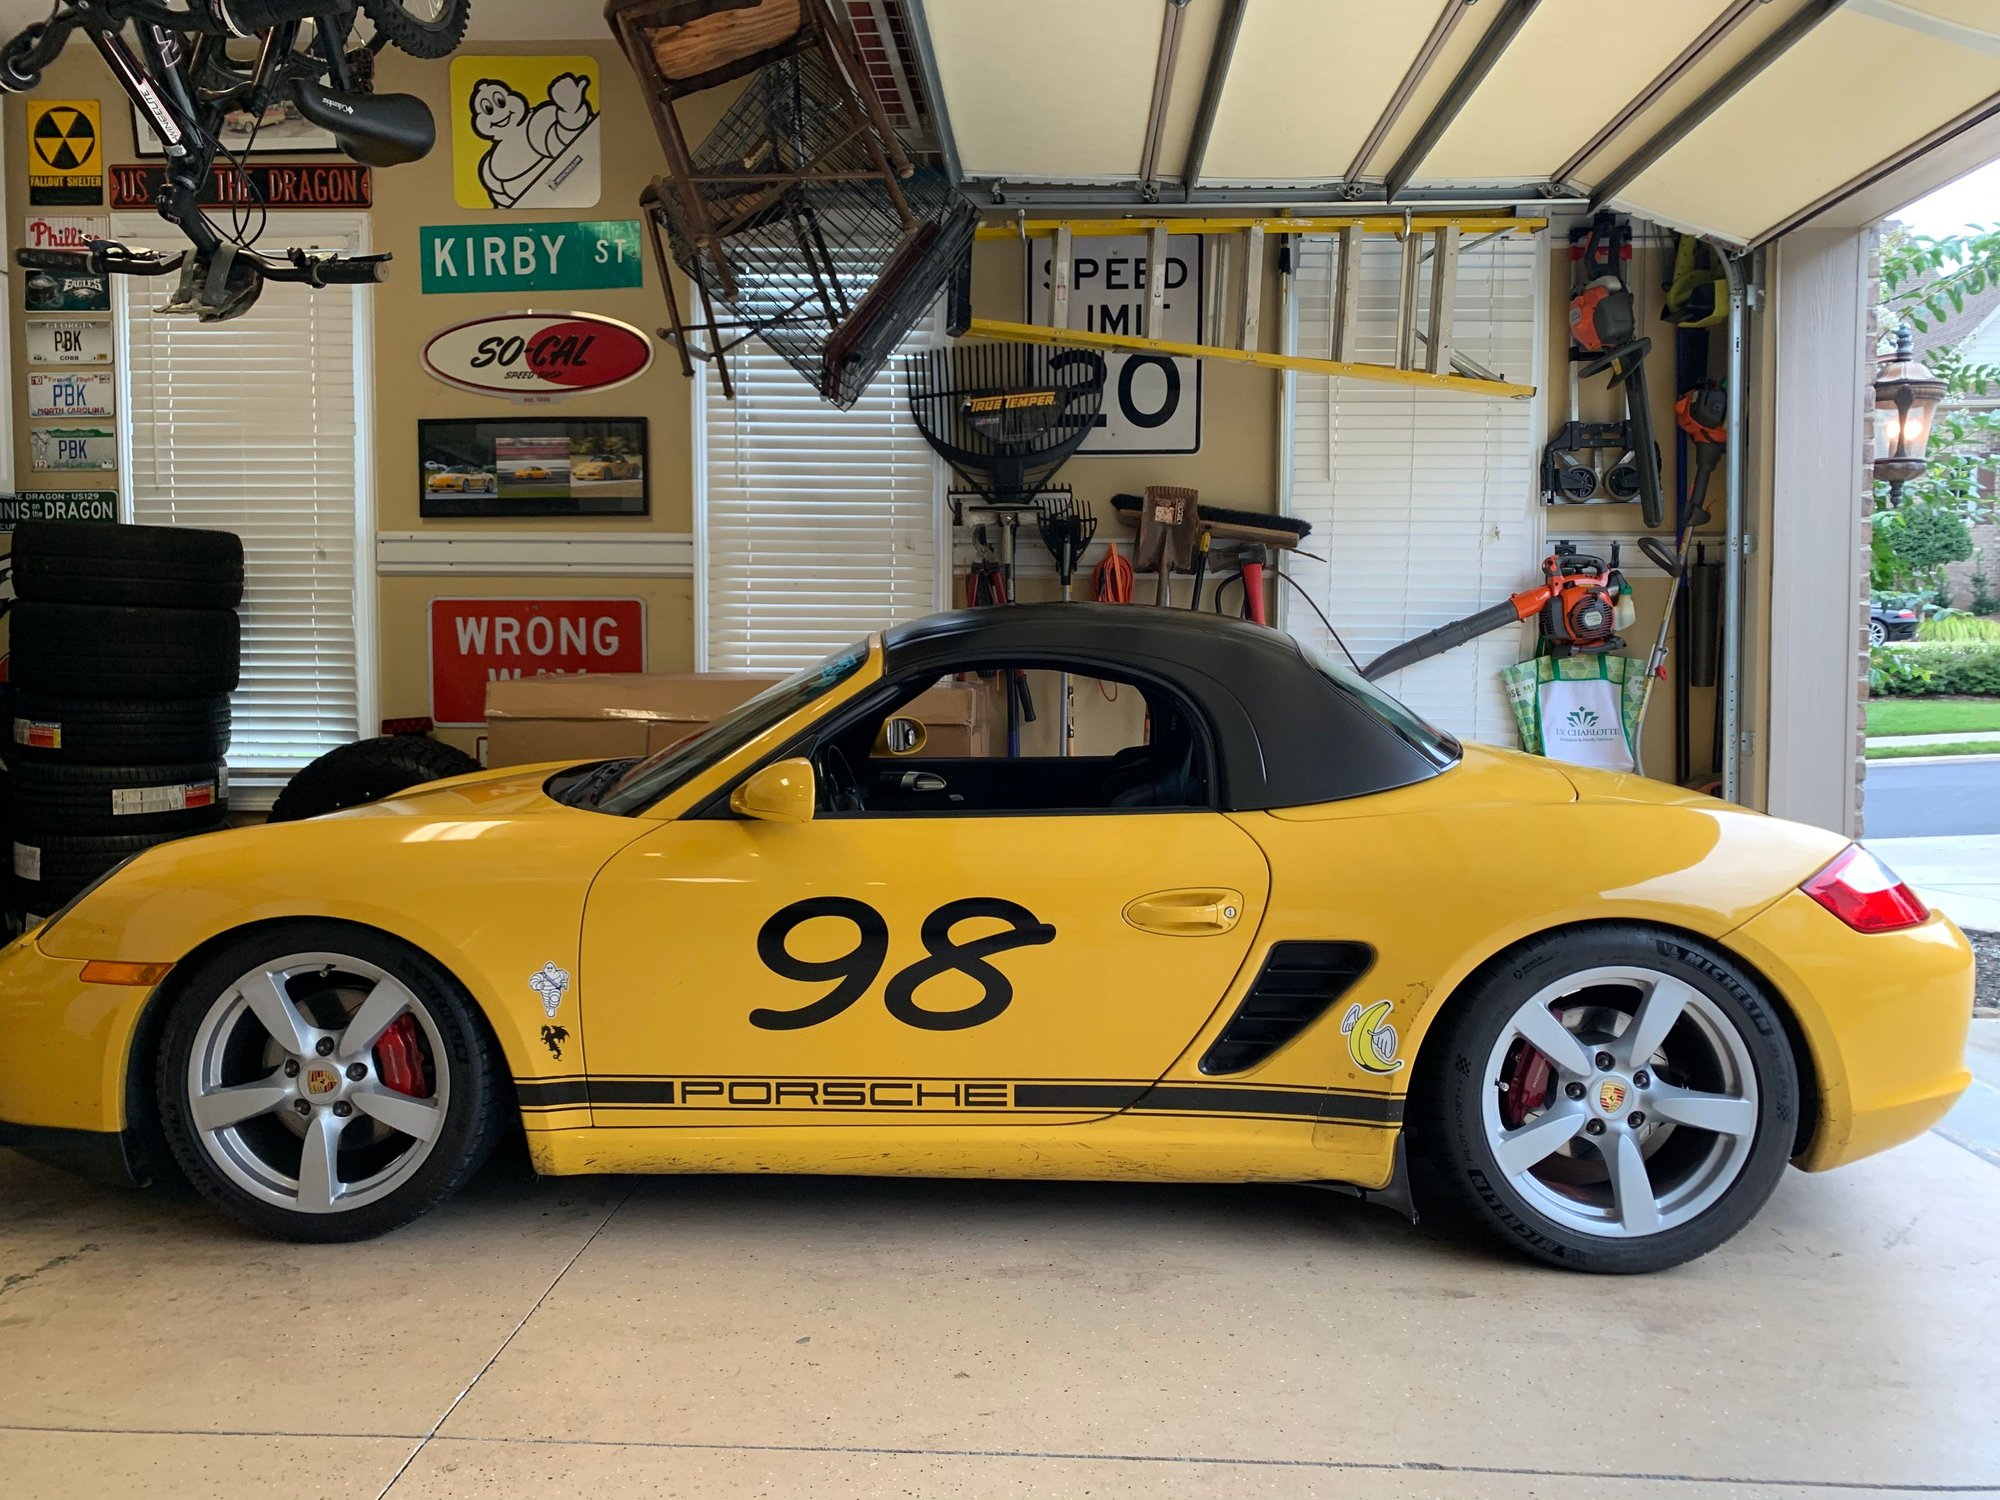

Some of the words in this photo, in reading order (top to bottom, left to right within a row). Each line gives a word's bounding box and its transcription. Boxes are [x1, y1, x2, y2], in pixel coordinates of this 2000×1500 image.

[30, 176, 64, 187] FALLOUT
[67, 176, 101, 187] SHELTER
[120, 170, 148, 202] US
[214, 169, 253, 201] THE
[269, 169, 358, 201] DRAGON
[434, 235, 565, 277] KIRBY
[594, 239, 626, 263] ST
[64, 278, 103, 292] EAGLES
[54, 330, 82, 352] PBK
[470, 336, 596, 368] SO-CAL
[504, 371, 534, 379] SPEED
[537, 371, 564, 379] SHOP
[53, 384, 86, 407] PBK
[1049, 350, 1180, 429] 20
[67, 407, 105, 415] CAROLINA
[969, 396, 1003, 412] TRUE
[1004, 391, 1056, 409] TEMPER
[58, 440, 87, 459] PBK
[32, 510, 43, 518] the
[44, 501, 113, 519] DRAGON
[455, 616, 620, 656] WRONG
[1567, 728, 1619, 737] CHARLOTTE
[749, 896, 1056, 1031] 98
[1684, 951, 1772, 1032] MICHELIN
[681, 1081, 1008, 1107] PORSCHE
